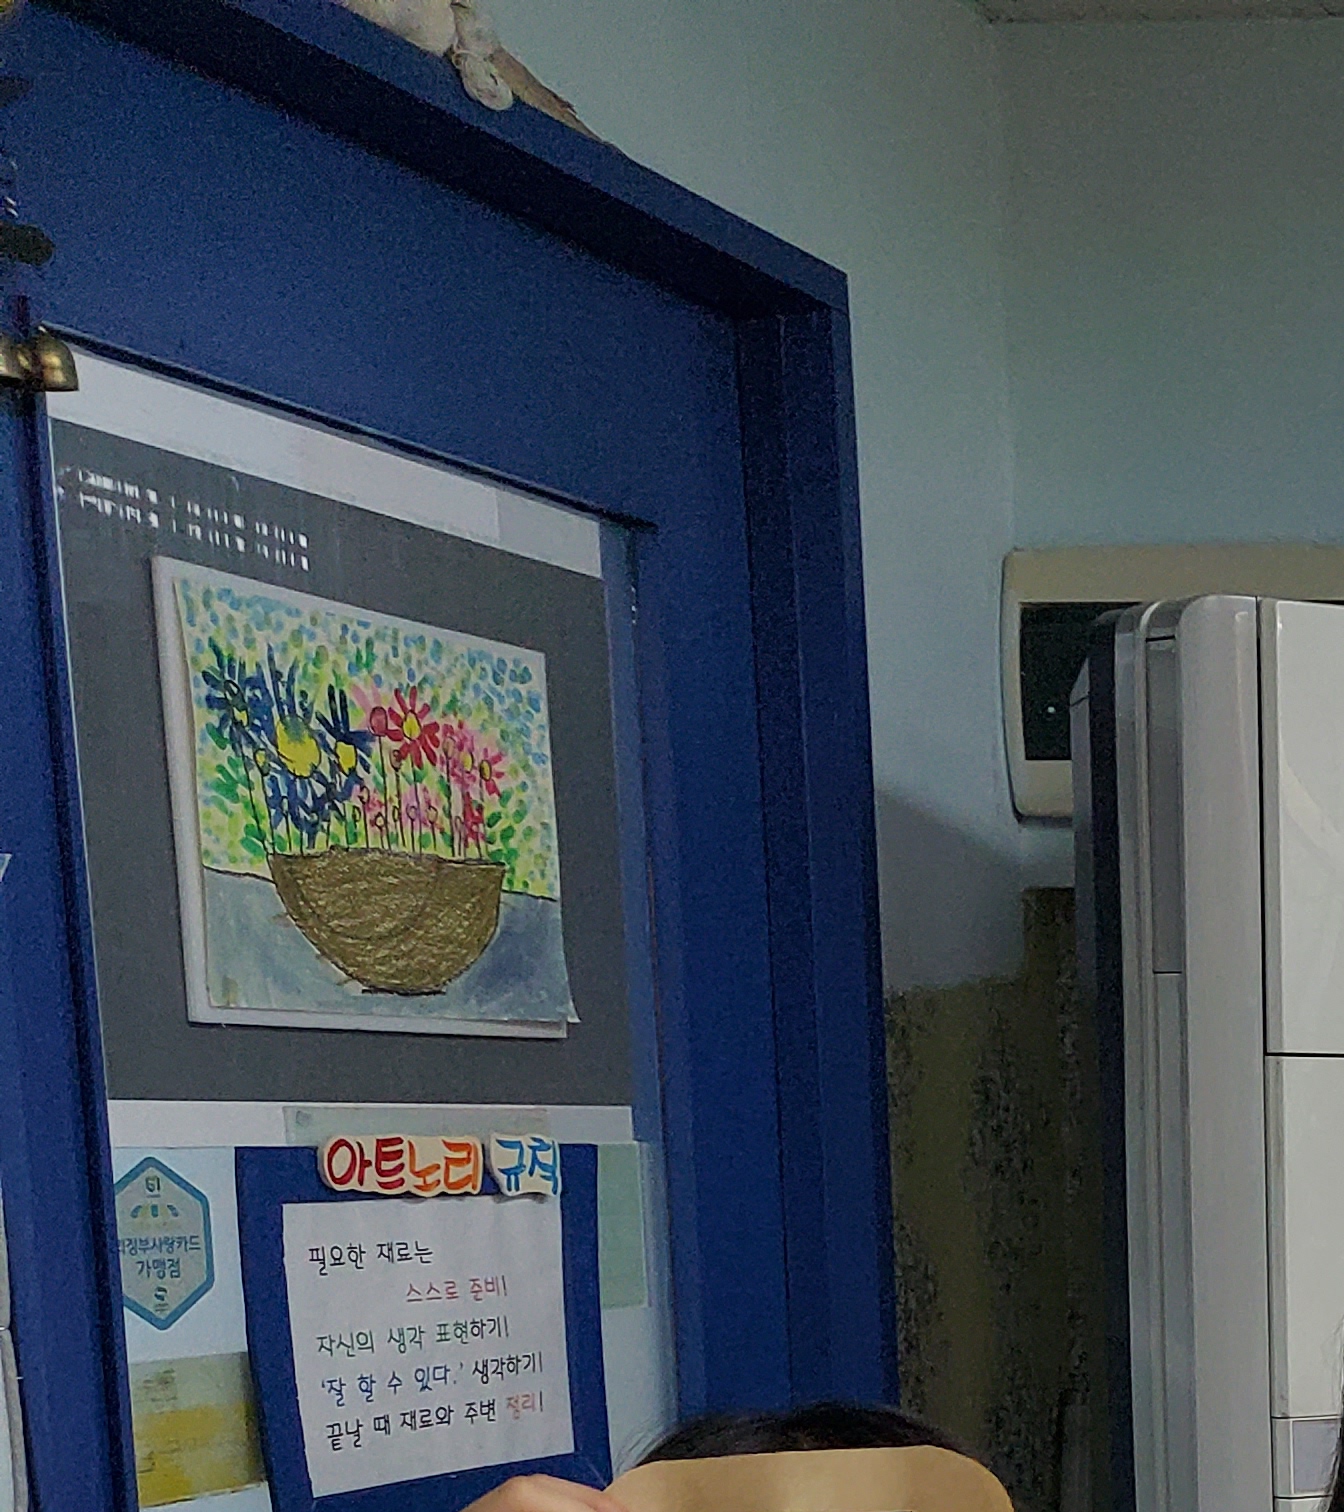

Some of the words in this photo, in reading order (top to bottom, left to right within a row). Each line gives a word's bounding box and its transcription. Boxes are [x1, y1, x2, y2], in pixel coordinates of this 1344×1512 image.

[327, 1137, 480, 1191] 아트노리
[497, 1137, 558, 1195] 규칙
[136, 1258, 181, 1279] 가맹점
[308, 1243, 366, 1276] 필요한
[377, 1241, 433, 1264] 재료는
[406, 1281, 460, 1302] 스스로
[317, 1329, 375, 1357] 자신의
[387, 1326, 426, 1354] 생각
[358, 1374, 376, 1402] 할
[387, 1371, 404, 1394] 수
[326, 1419, 363, 1451] 끝날
[373, 1415, 391, 1436] 때
[400, 1405, 454, 1430] 재료와
[464, 1399, 497, 1424] 주변
